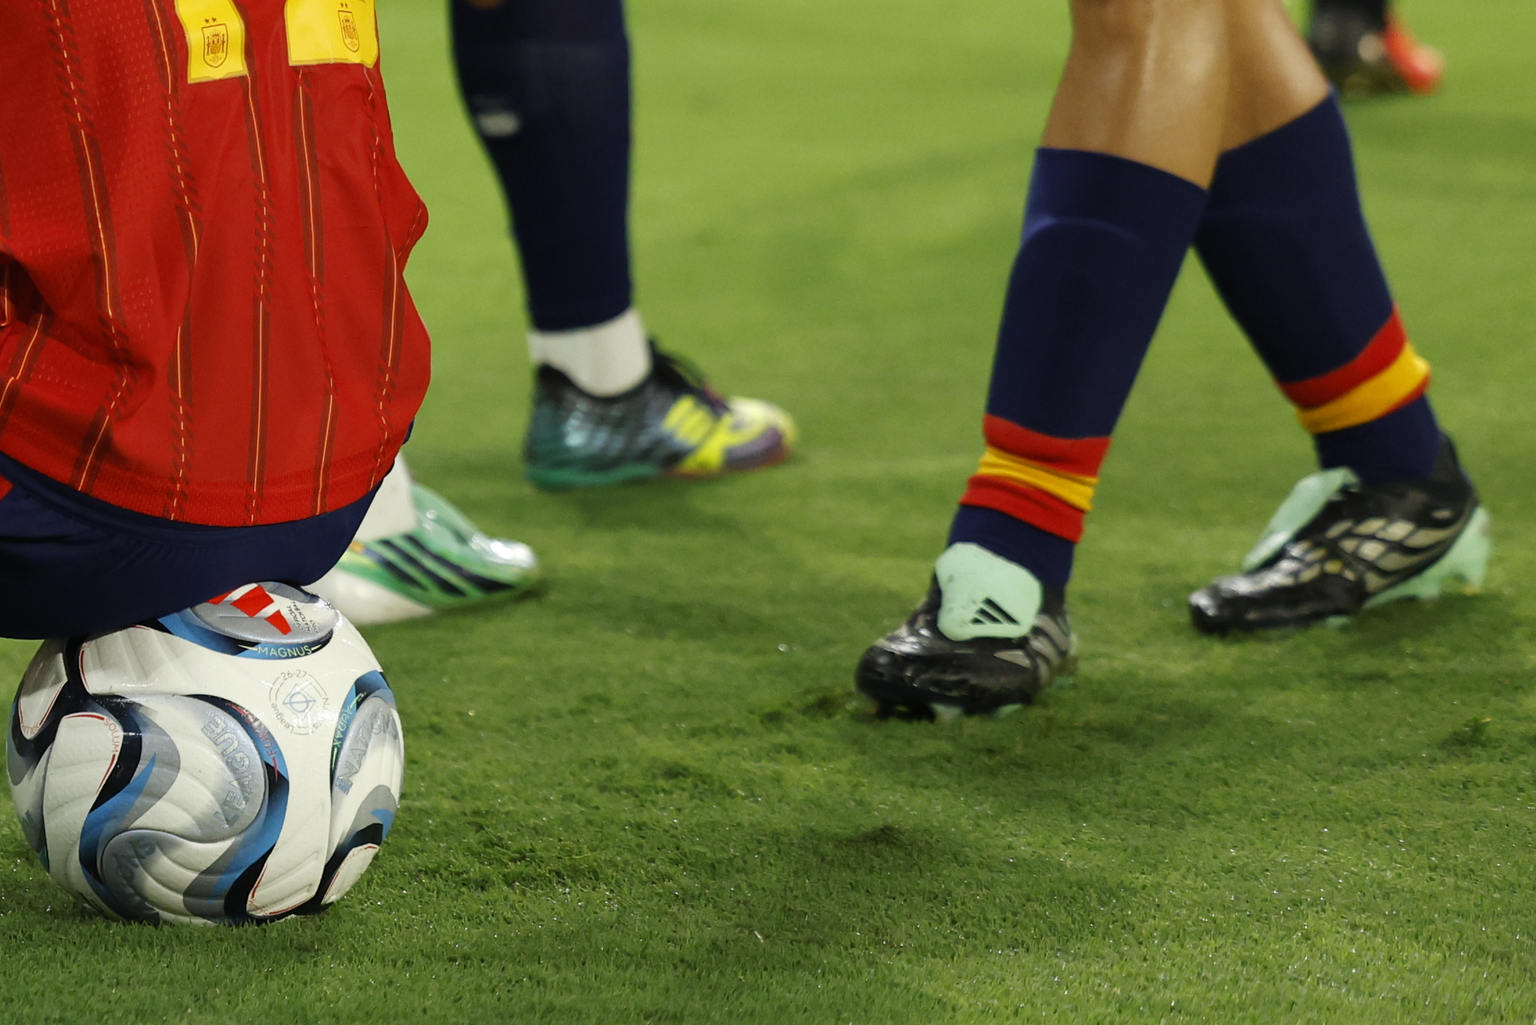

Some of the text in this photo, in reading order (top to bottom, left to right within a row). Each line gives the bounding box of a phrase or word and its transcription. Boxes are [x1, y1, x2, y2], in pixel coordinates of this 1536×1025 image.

[258, 645, 312, 658] MAGNUS
[280, 669, 307, 681] 26-27
[271, 703, 295, 733] League
[333, 706, 353, 747] AUDAX
[103, 717, 121, 753] SOLUM
[200, 715, 254, 827] LEAGUE
